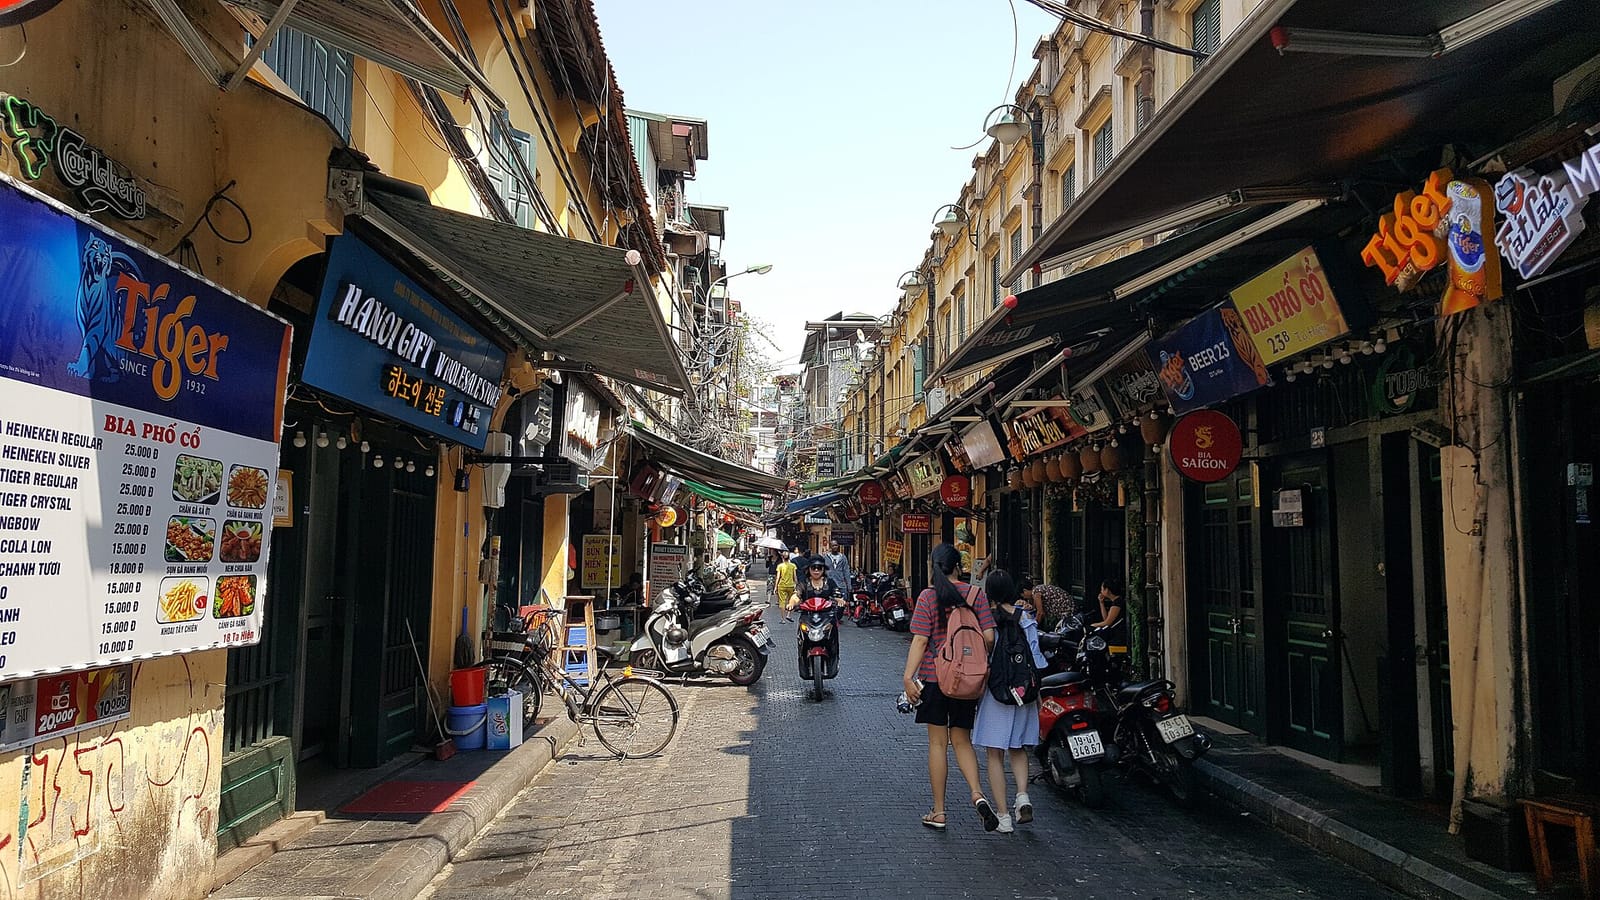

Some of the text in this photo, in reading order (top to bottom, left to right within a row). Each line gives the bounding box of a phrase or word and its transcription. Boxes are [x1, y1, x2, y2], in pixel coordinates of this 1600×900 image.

[57, 128, 146, 219] Carlsberg
[1361, 170, 1452, 286] Tiger
[337, 283, 403, 350] HANOI
[397, 322, 437, 369] GIFT
[1243, 303, 1275, 335] BIA
[115, 271, 229, 401] Tiger
[1188, 341, 1231, 372] BEER 23
[120, 358, 206, 395] SINCE 1932
[388, 365, 446, 417] 하노이 선물
[5, 421, 104, 451] HEINEKEN REGULAR
[103, 414, 201, 449] BIA PHỐ CỔ
[2, 444, 91, 469] HEINEKEN SILVER
[124, 443, 152, 458] 25.000
[122, 463, 149, 477] 25.000
[1182, 457, 1227, 469] SAIGON
[0, 468, 78, 490] TIGER REGULAR
[119, 483, 147, 497] 25.000
[30, 494, 72, 511] CRYSTAL
[117, 503, 144, 516] 25.000
[114, 523, 141, 535] 25.000
[0, 539, 52, 554] COLA LON
[112, 542, 139, 554] 15.000
[109, 562, 136, 574] 18.000
[107, 582, 134, 594] 15.000
[104, 601, 131, 614] 15.000
[102, 621, 129, 634] 15.000
[99, 641, 126, 655] 10.000
